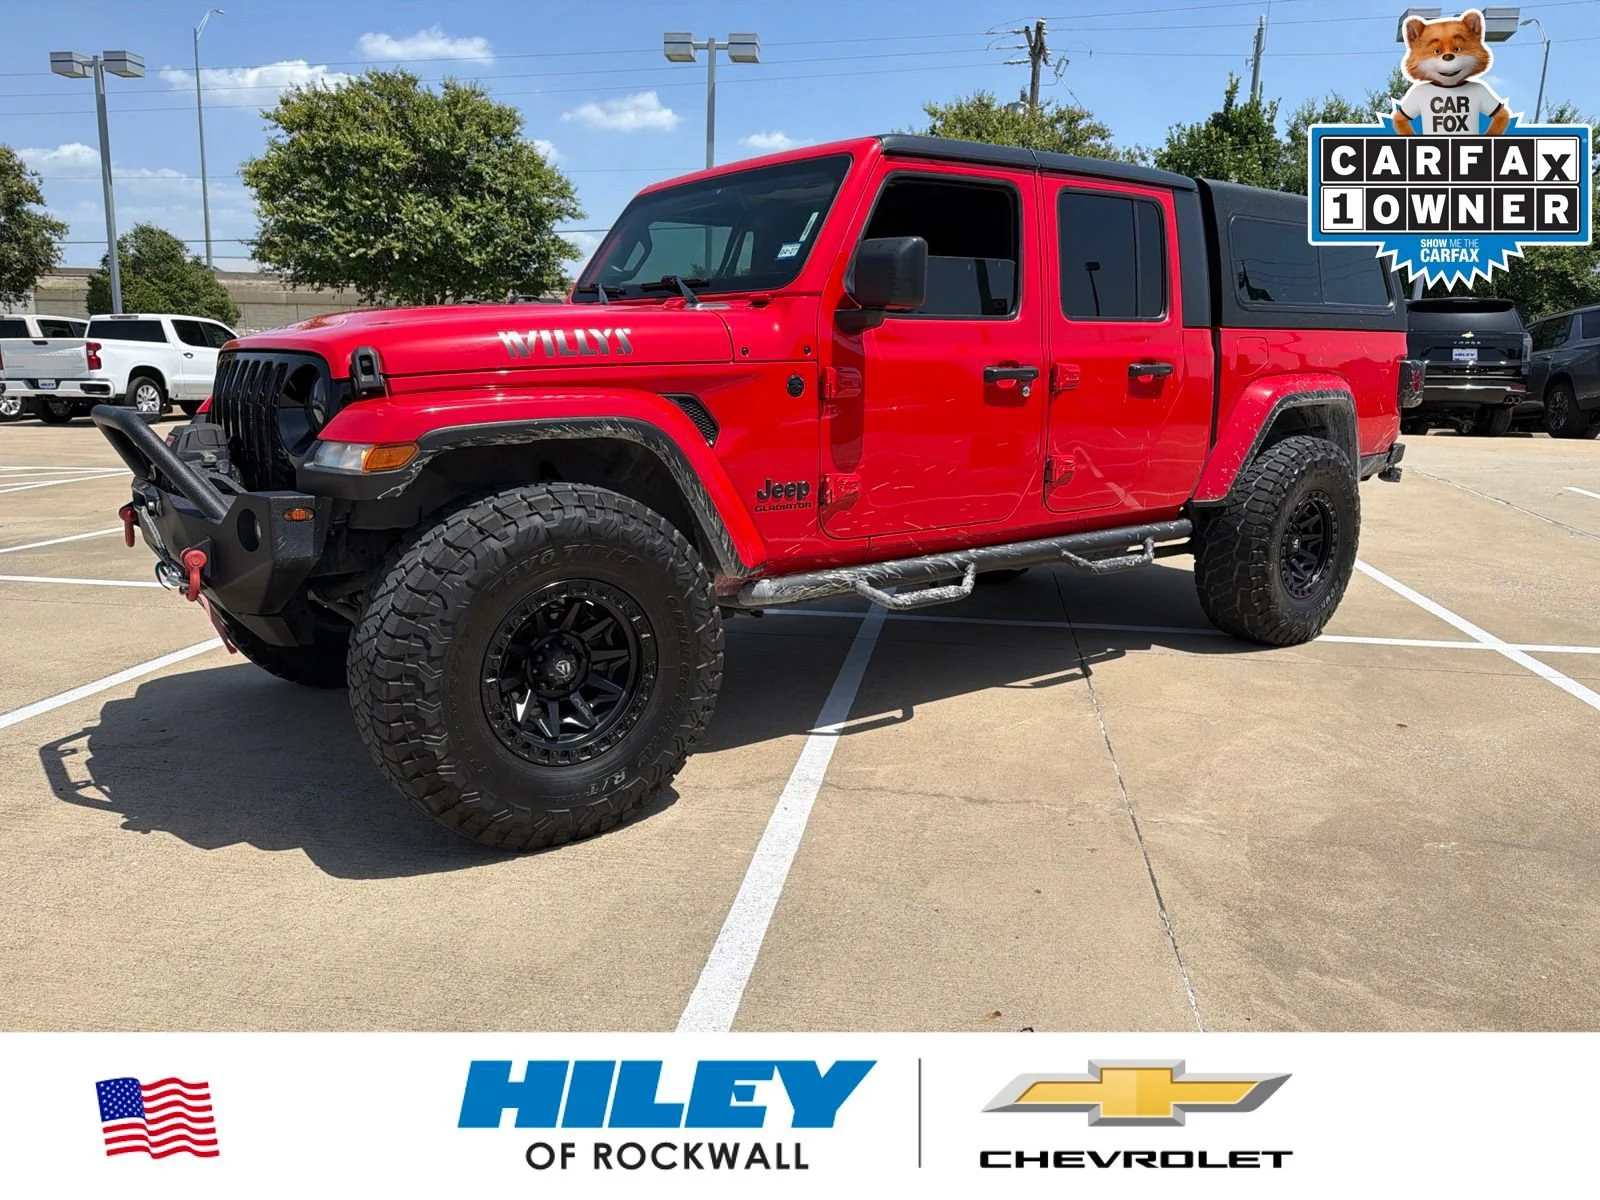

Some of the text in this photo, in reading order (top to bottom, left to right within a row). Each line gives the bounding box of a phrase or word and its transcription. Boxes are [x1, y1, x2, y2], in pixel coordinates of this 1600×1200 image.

[497, 328, 633, 358] WILLYS
[756, 479, 810, 500] Jeep
[754, 502, 812, 512] GLADIATOR
